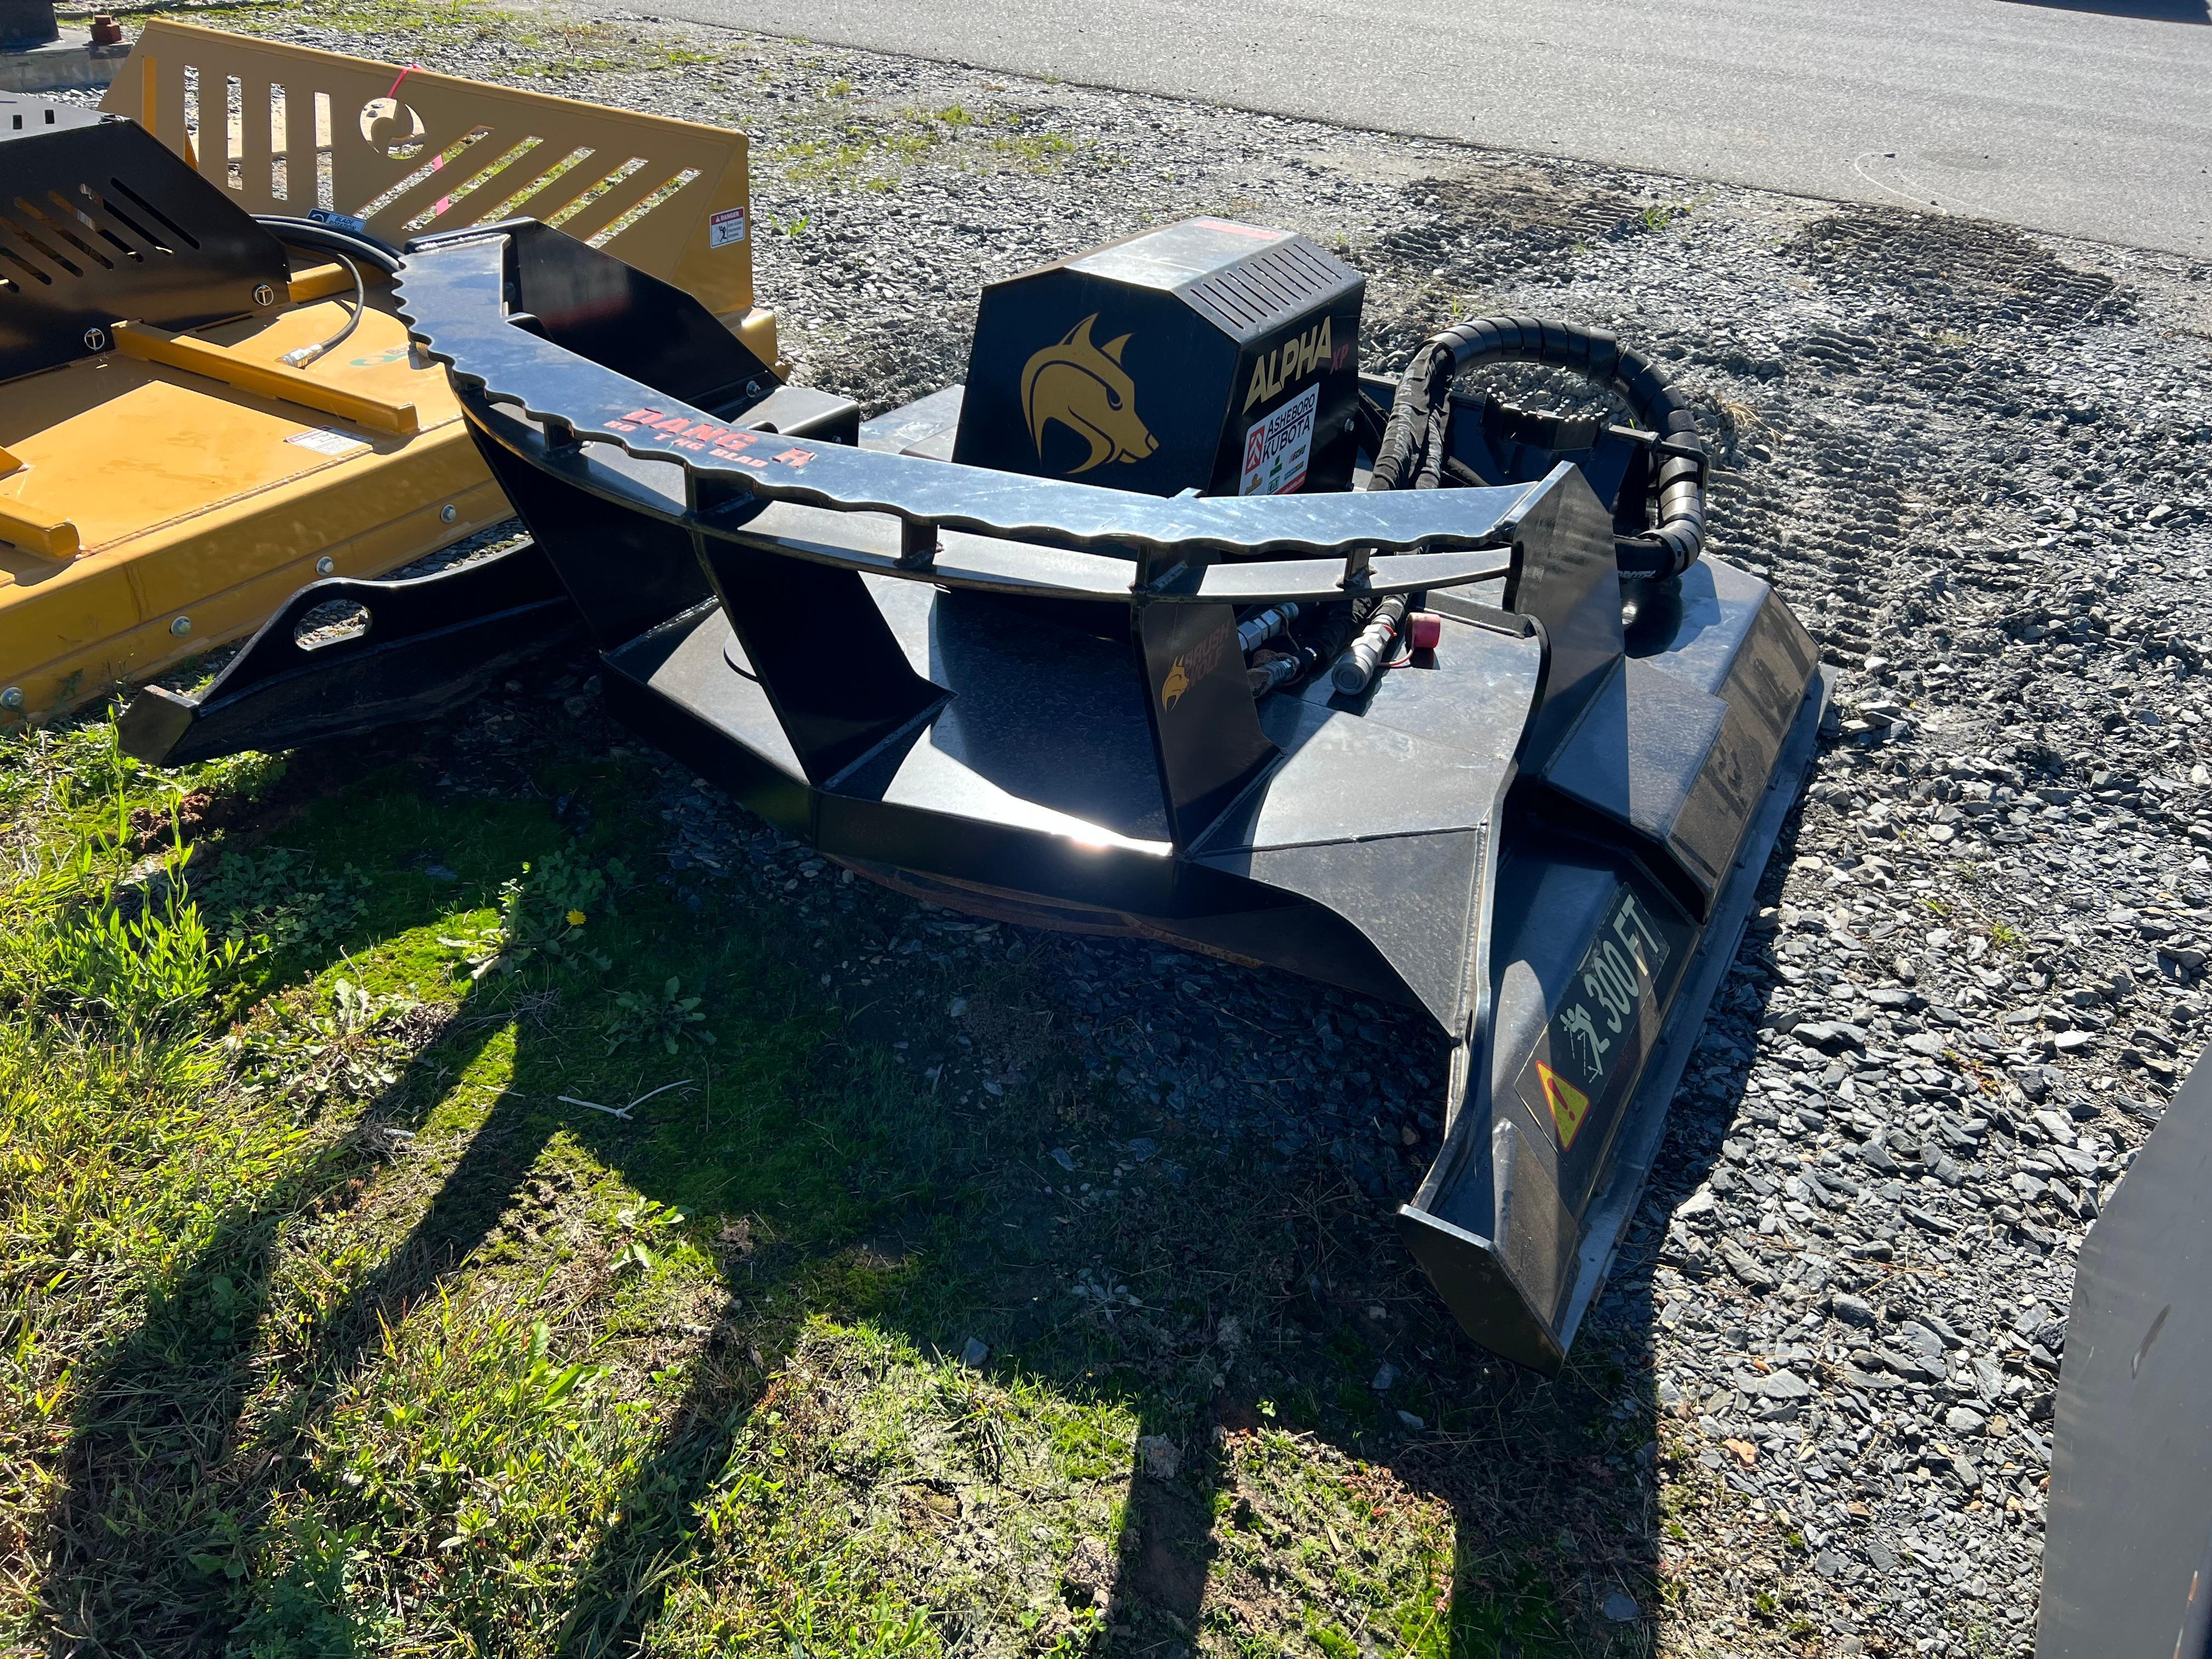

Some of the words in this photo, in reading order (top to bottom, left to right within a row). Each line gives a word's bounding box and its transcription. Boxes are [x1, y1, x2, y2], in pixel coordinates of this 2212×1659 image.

[335, 217, 355, 225] BLADE
[720, 211, 739, 221] DANGER
[1242, 316, 1331, 415] ALPHA
[1329, 343, 1348, 375] XP
[1262, 415, 1310, 463] KUBOTA
[1265, 393, 1315, 441] ASHEBORO
[1584, 940, 1639, 1034] 300
[1613, 894, 1659, 977] FT
